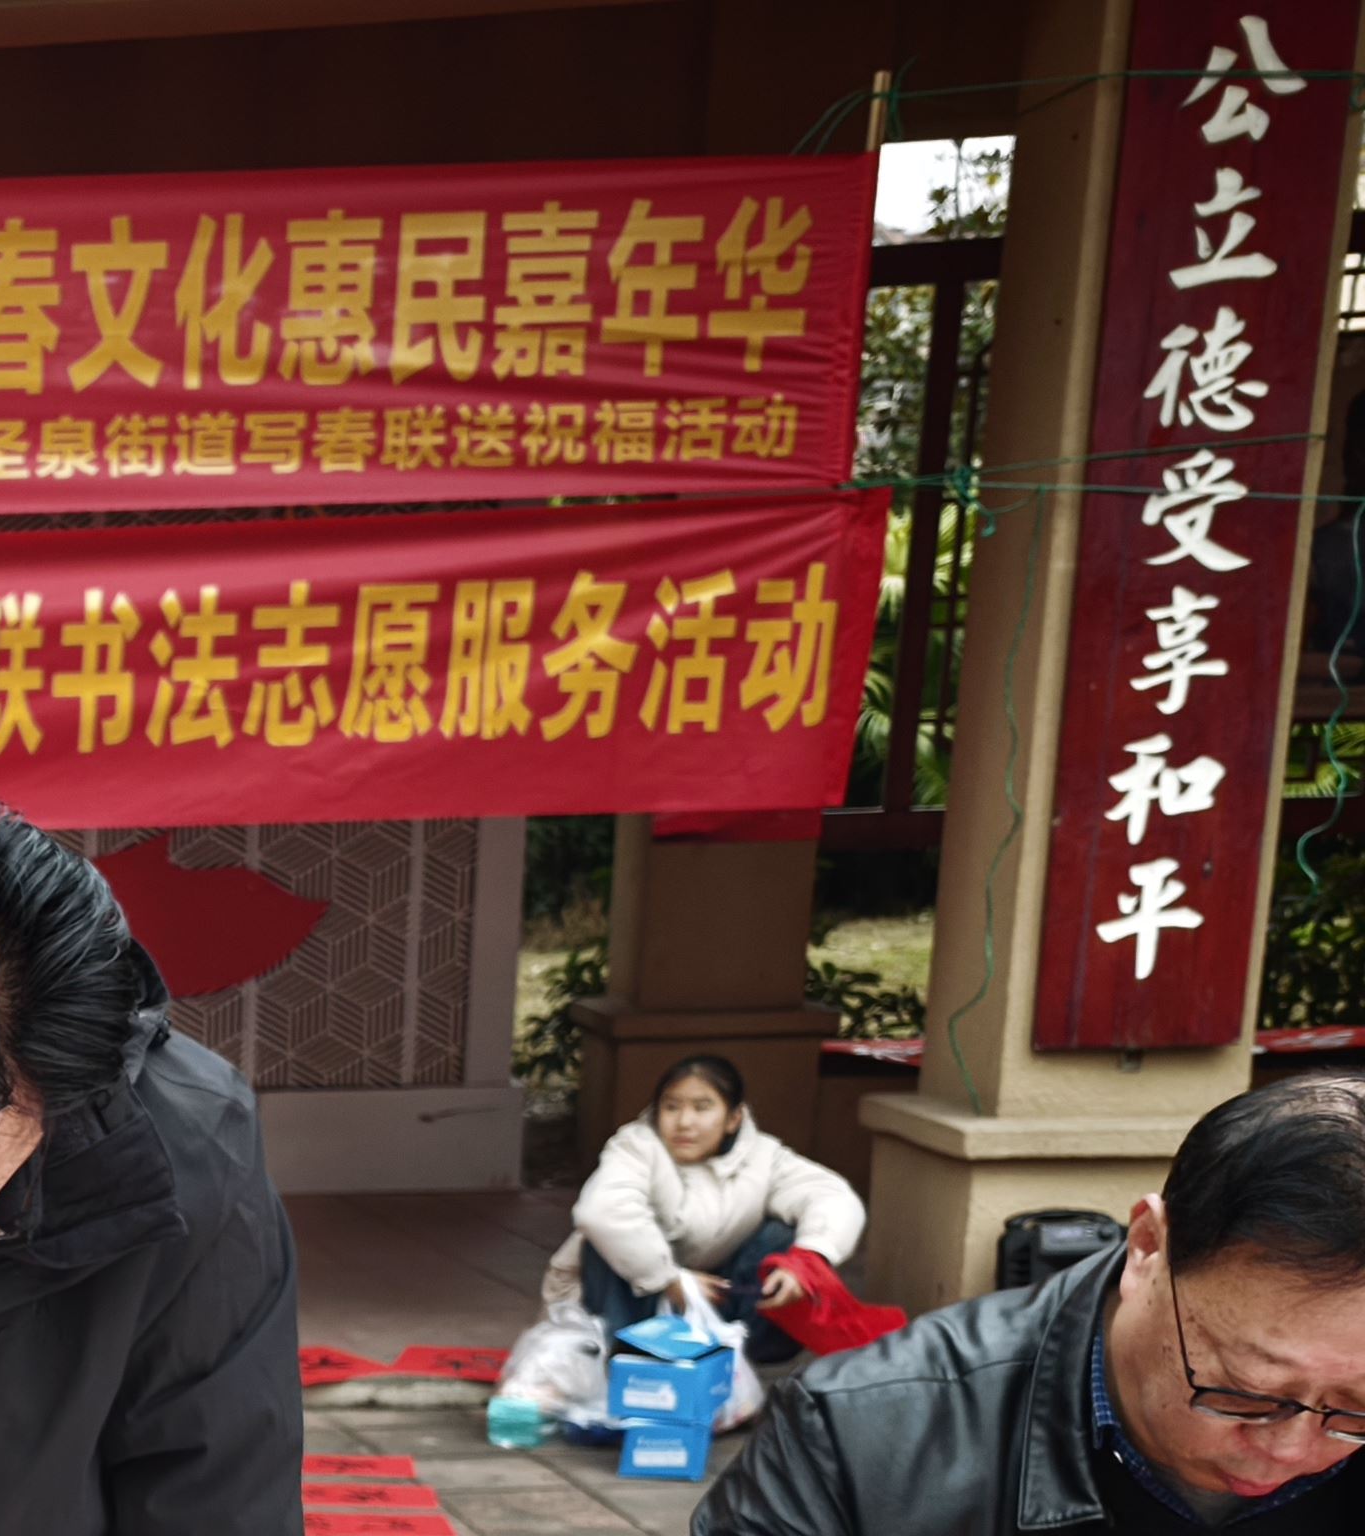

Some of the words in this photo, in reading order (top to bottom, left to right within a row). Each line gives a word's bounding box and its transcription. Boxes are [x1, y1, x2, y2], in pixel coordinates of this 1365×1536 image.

[1095, 14, 1307, 980] 公立德受享和平
